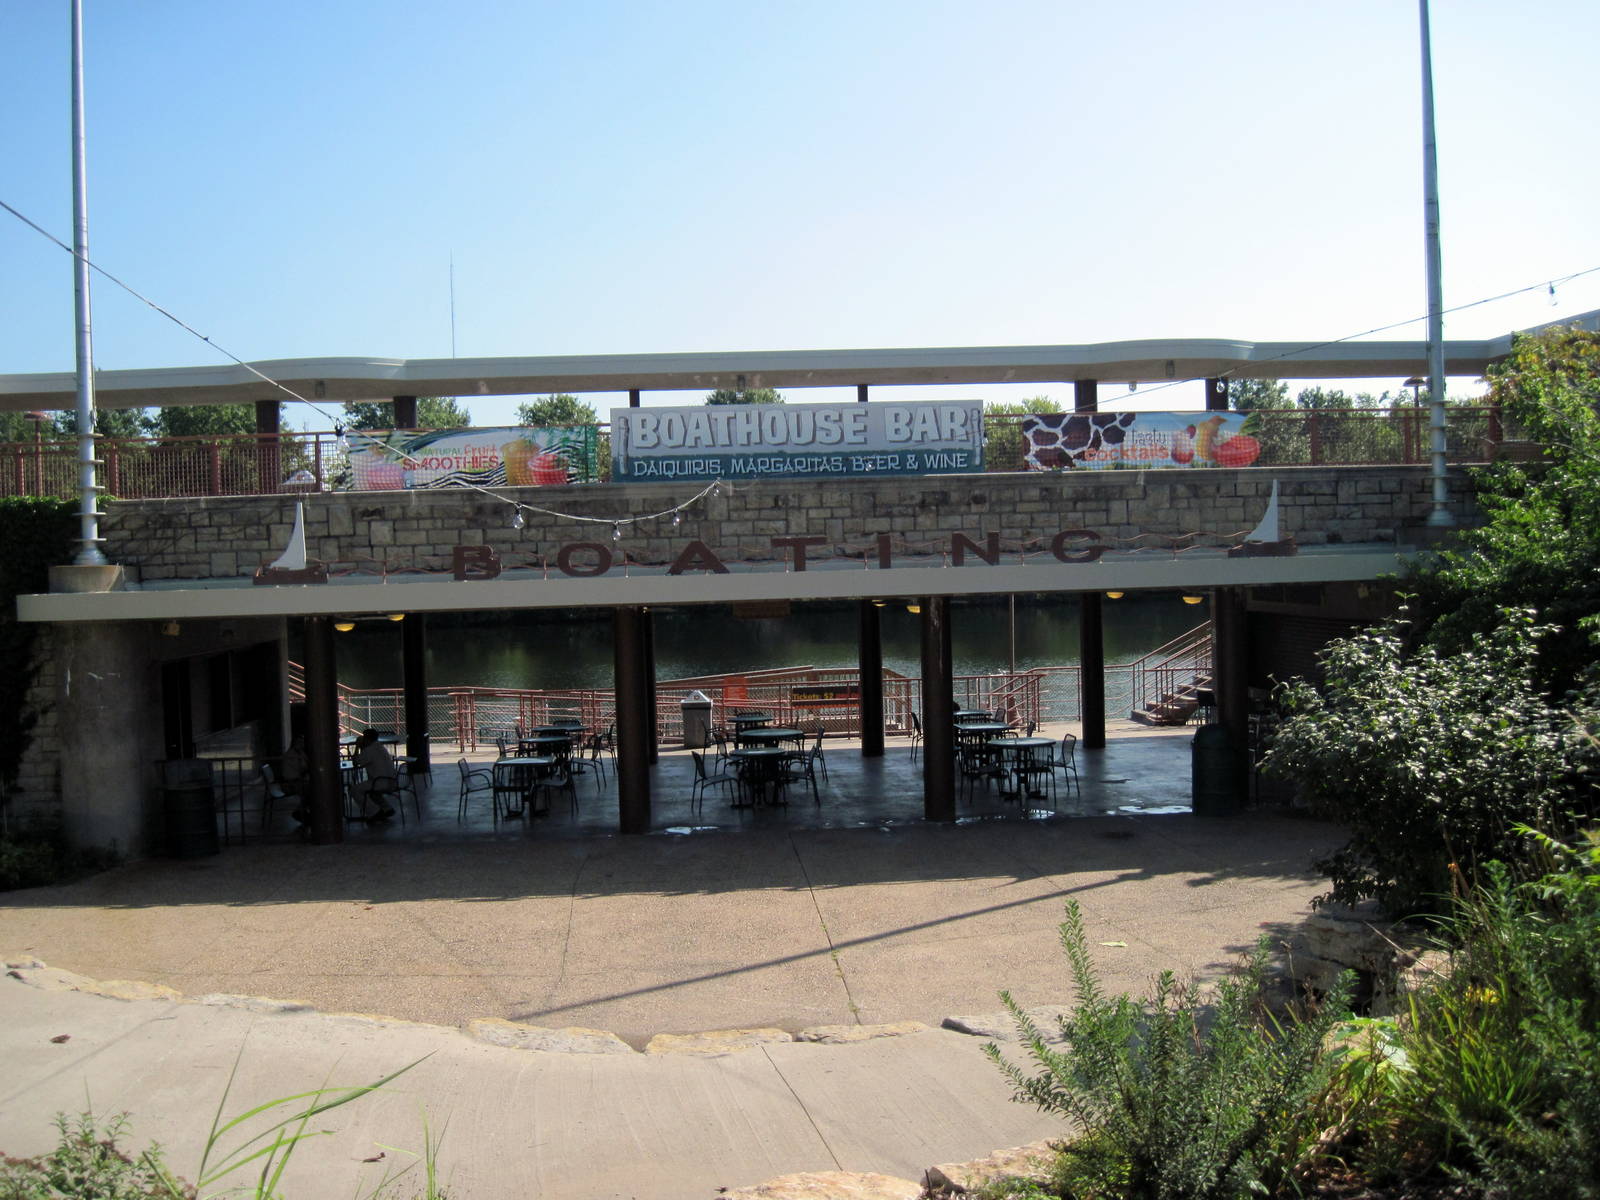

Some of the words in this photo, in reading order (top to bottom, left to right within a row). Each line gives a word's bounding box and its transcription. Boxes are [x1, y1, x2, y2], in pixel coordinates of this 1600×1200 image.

[632, 408, 868, 449] BOATHOUSE
[886, 406, 971, 444] BAR
[1131, 428, 1167, 448] tasty
[463, 444, 498, 456] Fruit
[1084, 443, 1169, 461] cocktails
[402, 456, 500, 471] SMOOTHIES
[633, 459, 726, 479] DAIQUIRIS,
[730, 454, 847, 476] MARGARITAS,
[852, 455, 902, 473] BEER
[906, 454, 919, 470] &
[923, 453, 968, 468] WINE
[453, 528, 1103, 582] BOATING
